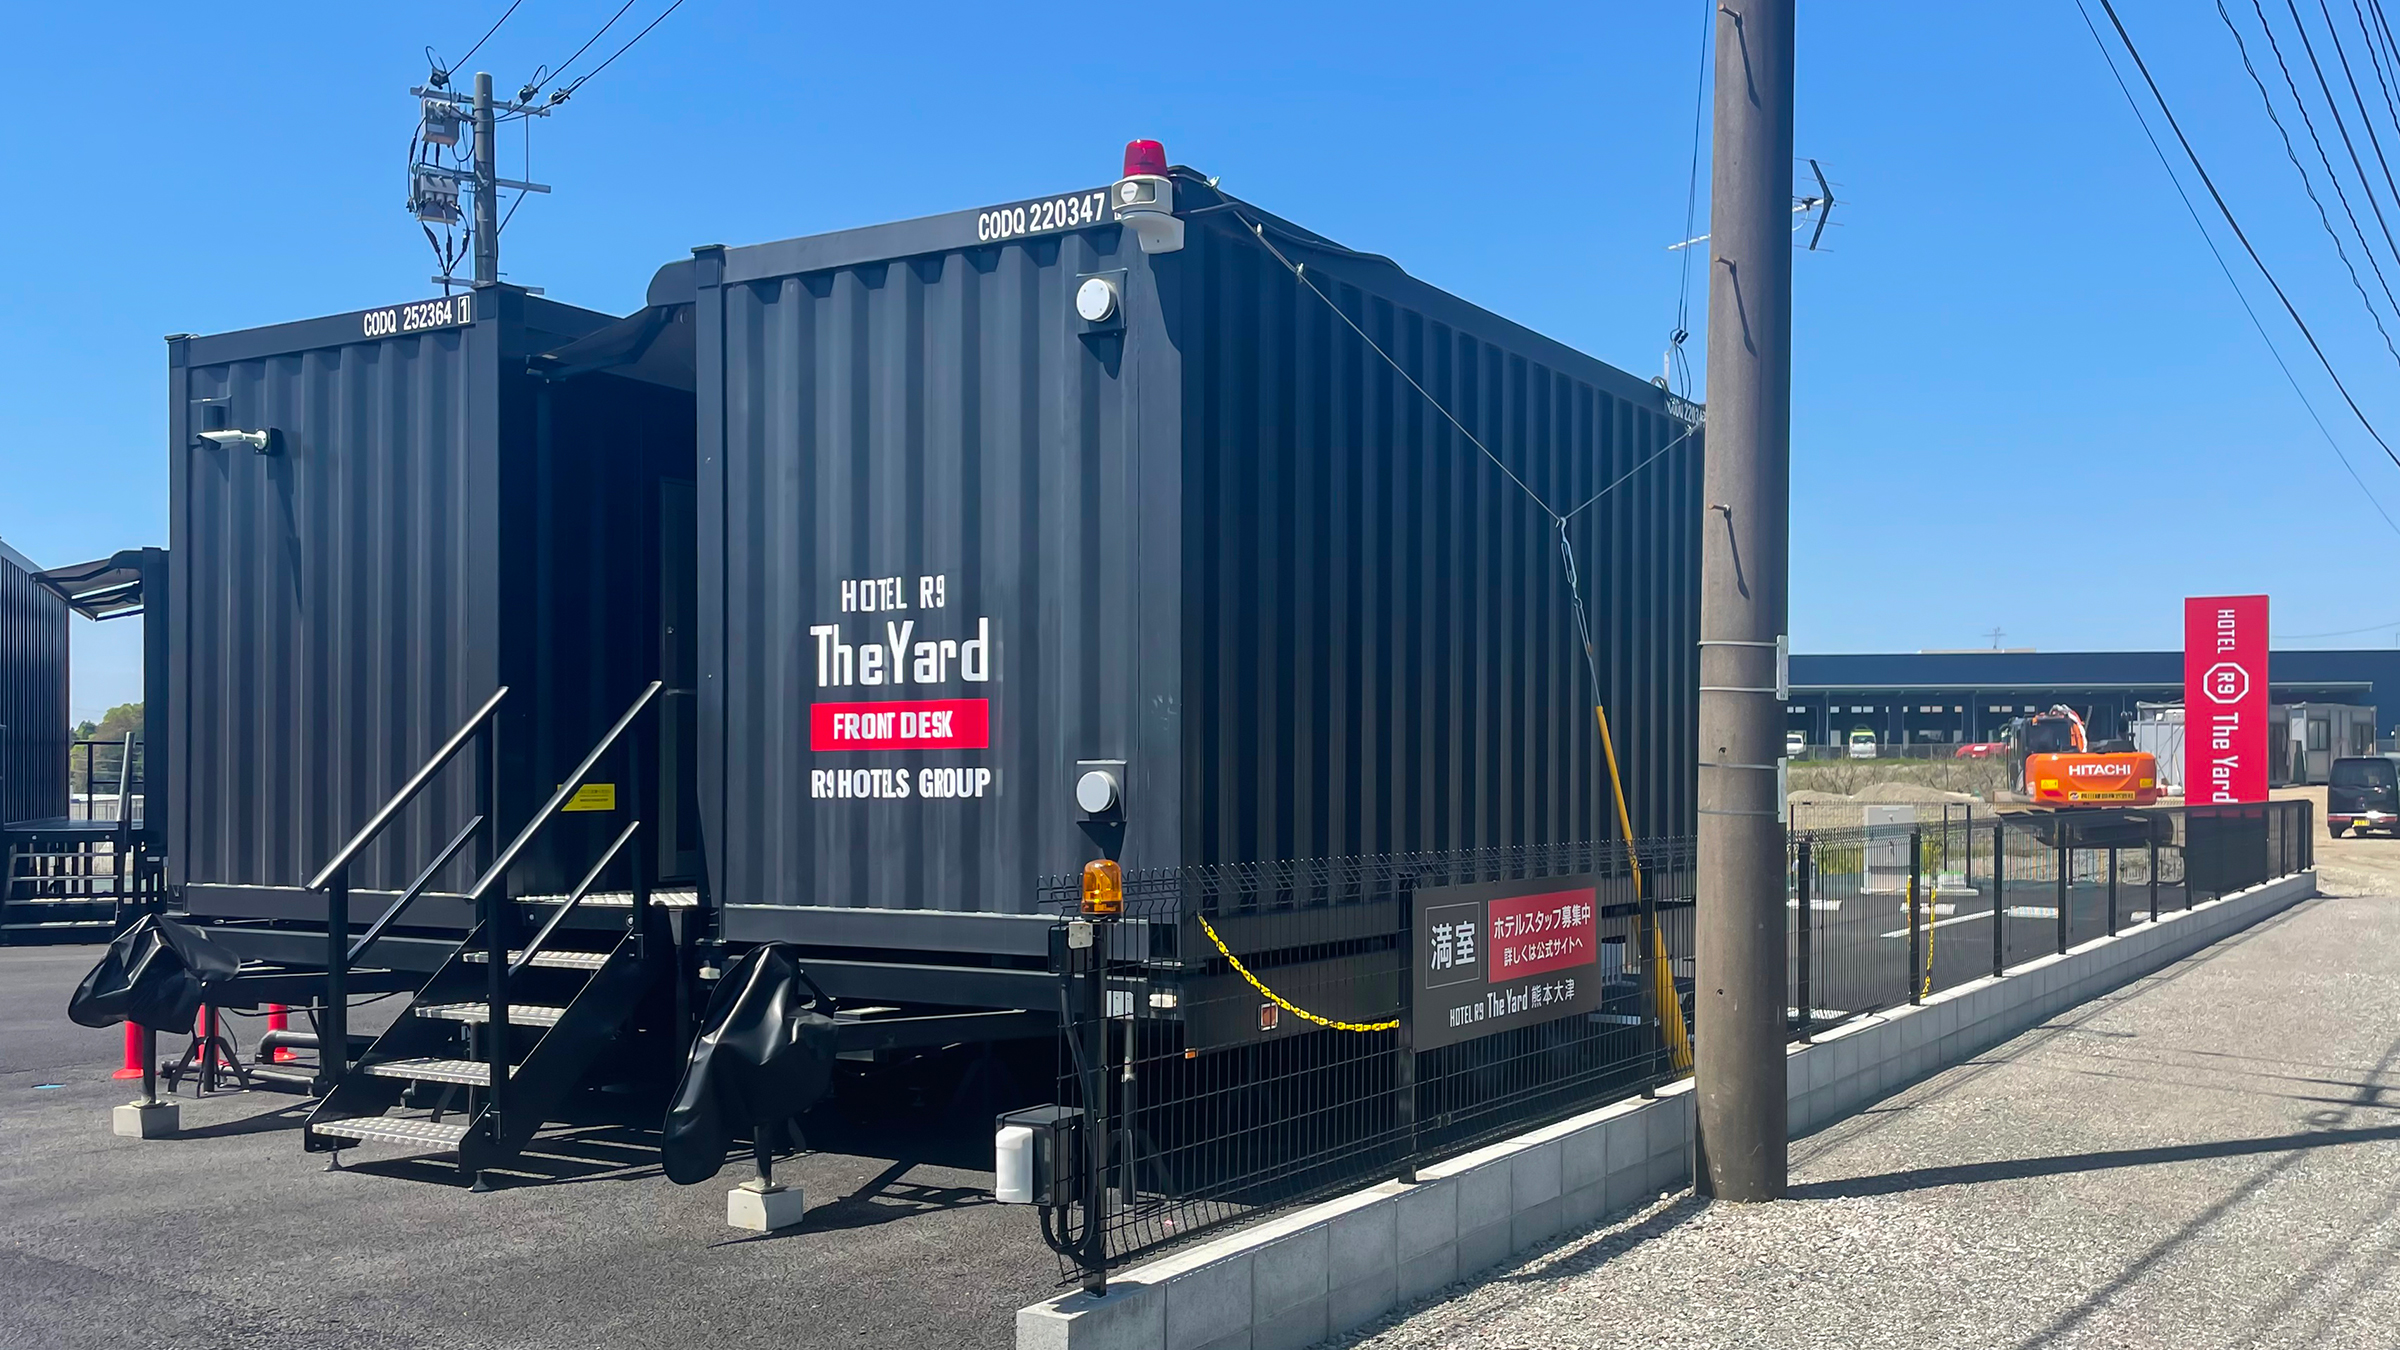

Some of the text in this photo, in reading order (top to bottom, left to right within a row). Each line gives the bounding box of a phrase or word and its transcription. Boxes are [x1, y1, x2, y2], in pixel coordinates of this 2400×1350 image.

[978, 192, 1105, 241] CODQ 220347
[363, 309, 397, 337] CODQ
[403, 299, 453, 331] 252364
[841, 574, 945, 613] HOTEL R9
[833, 710, 953, 740] FRONT DESK
[2212, 609, 2240, 804] HOTEL R9 The Yard
[918, 767, 991, 798] GROUP
[2068, 764, 2132, 776] HITACHI
[1493, 902, 1591, 940] ホテルスタッフ募集中
[1430, 920, 1476, 970] 満室
[1503, 936, 1584, 967] 詳しくは公式サイトへ
[1449, 978, 1575, 1028] HOTEL R9 The Yard 熊本大津
